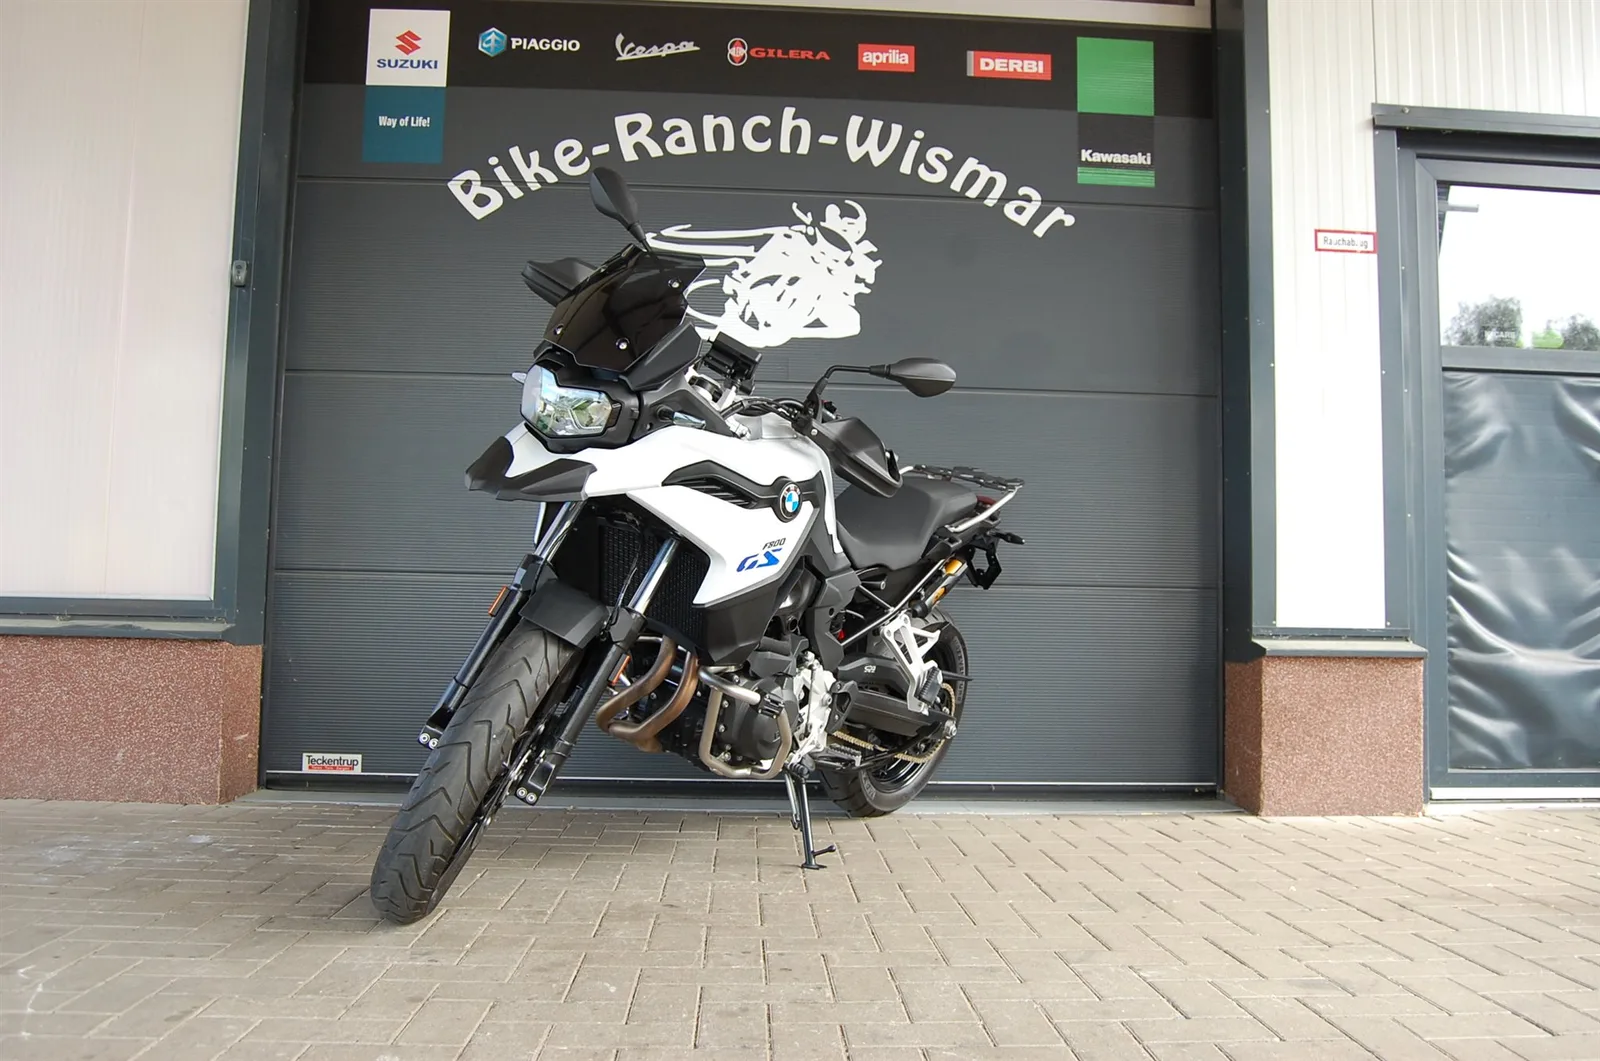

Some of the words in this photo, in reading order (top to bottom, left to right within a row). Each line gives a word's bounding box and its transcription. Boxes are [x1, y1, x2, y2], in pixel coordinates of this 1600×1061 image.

[510, 37, 581, 52] PIAGGIO
[615, 32, 701, 61] Vespa
[749, 47, 831, 61] GILERA
[862, 49, 909, 66] aprilia
[376, 58, 438, 70] SUZUKI
[979, 57, 1044, 74] DERBI
[378, 115, 398, 129] Way
[399, 115, 410, 127] of
[410, 116, 431, 128] Life!
[1080, 149, 1152, 165] Kawasaki
[1323, 235, 1369, 249] Rauchabug
[762, 538, 787, 552] F800
[736, 547, 783, 573] GS
[305, 755, 359, 769] Teckentrup
